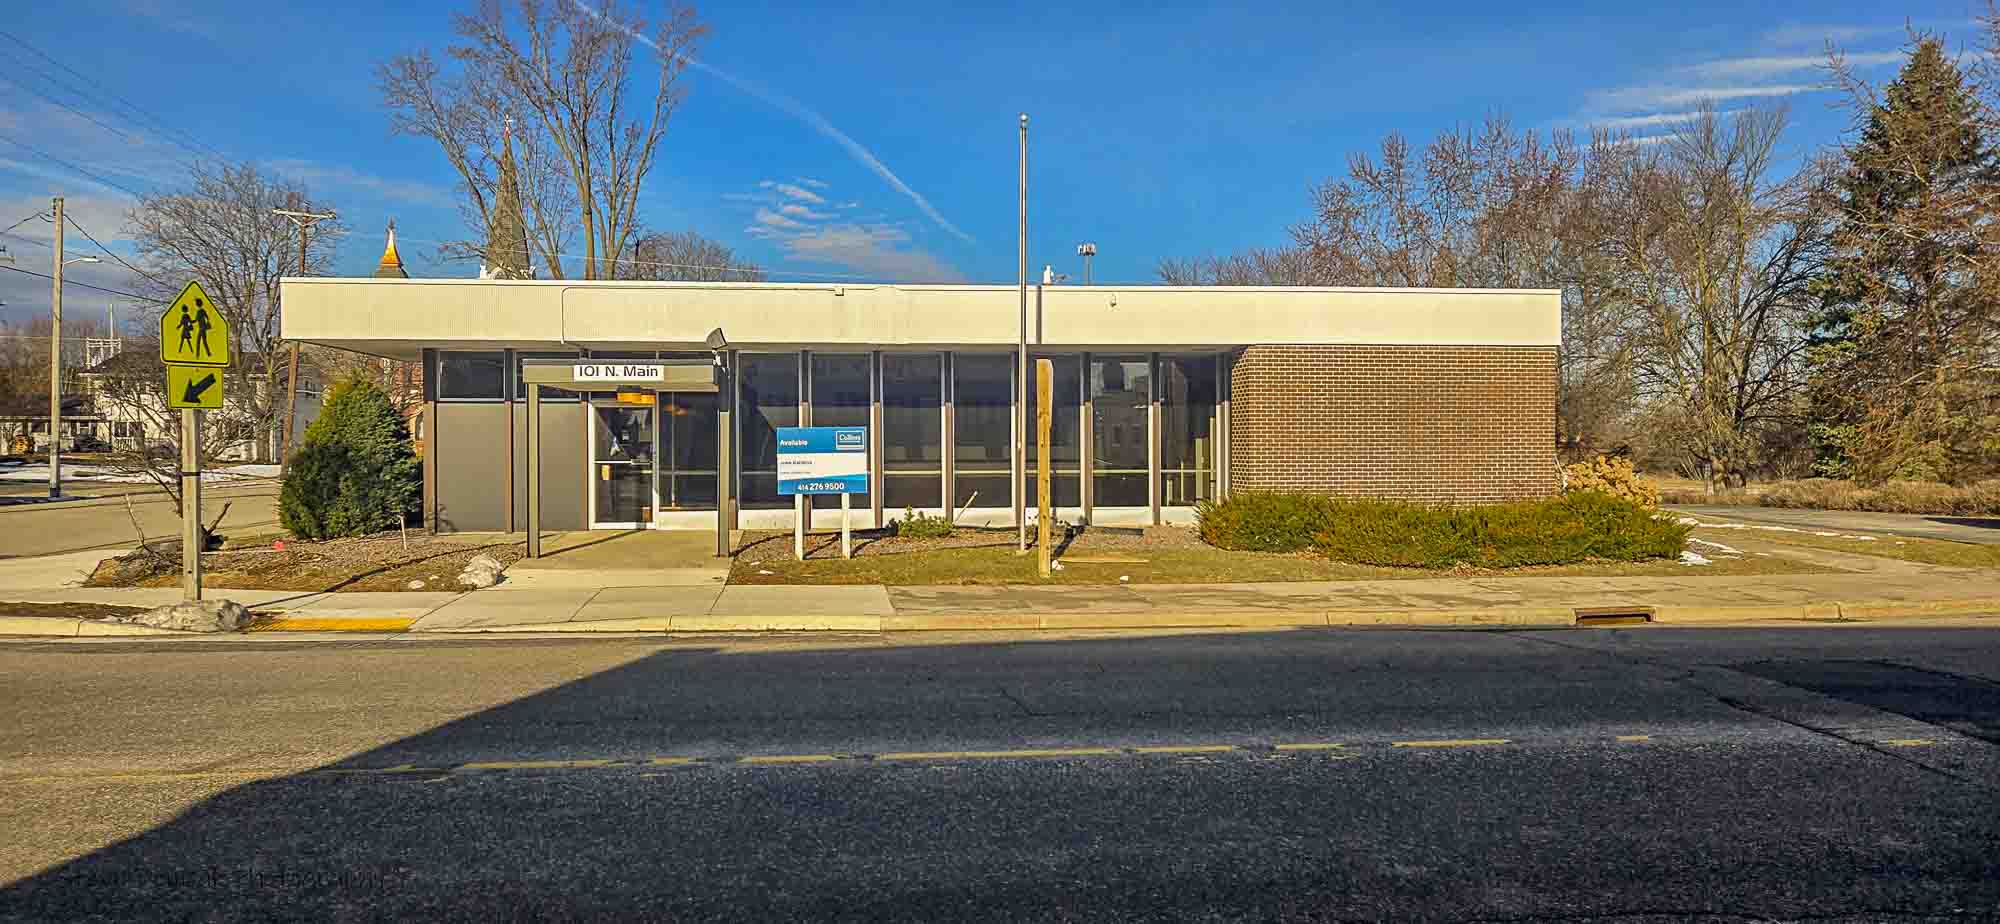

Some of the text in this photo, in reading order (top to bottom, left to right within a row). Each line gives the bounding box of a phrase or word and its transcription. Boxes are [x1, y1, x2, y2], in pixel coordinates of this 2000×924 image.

[579, 366, 658, 377] 101 N. Main
[810, 482, 824, 490] 276
